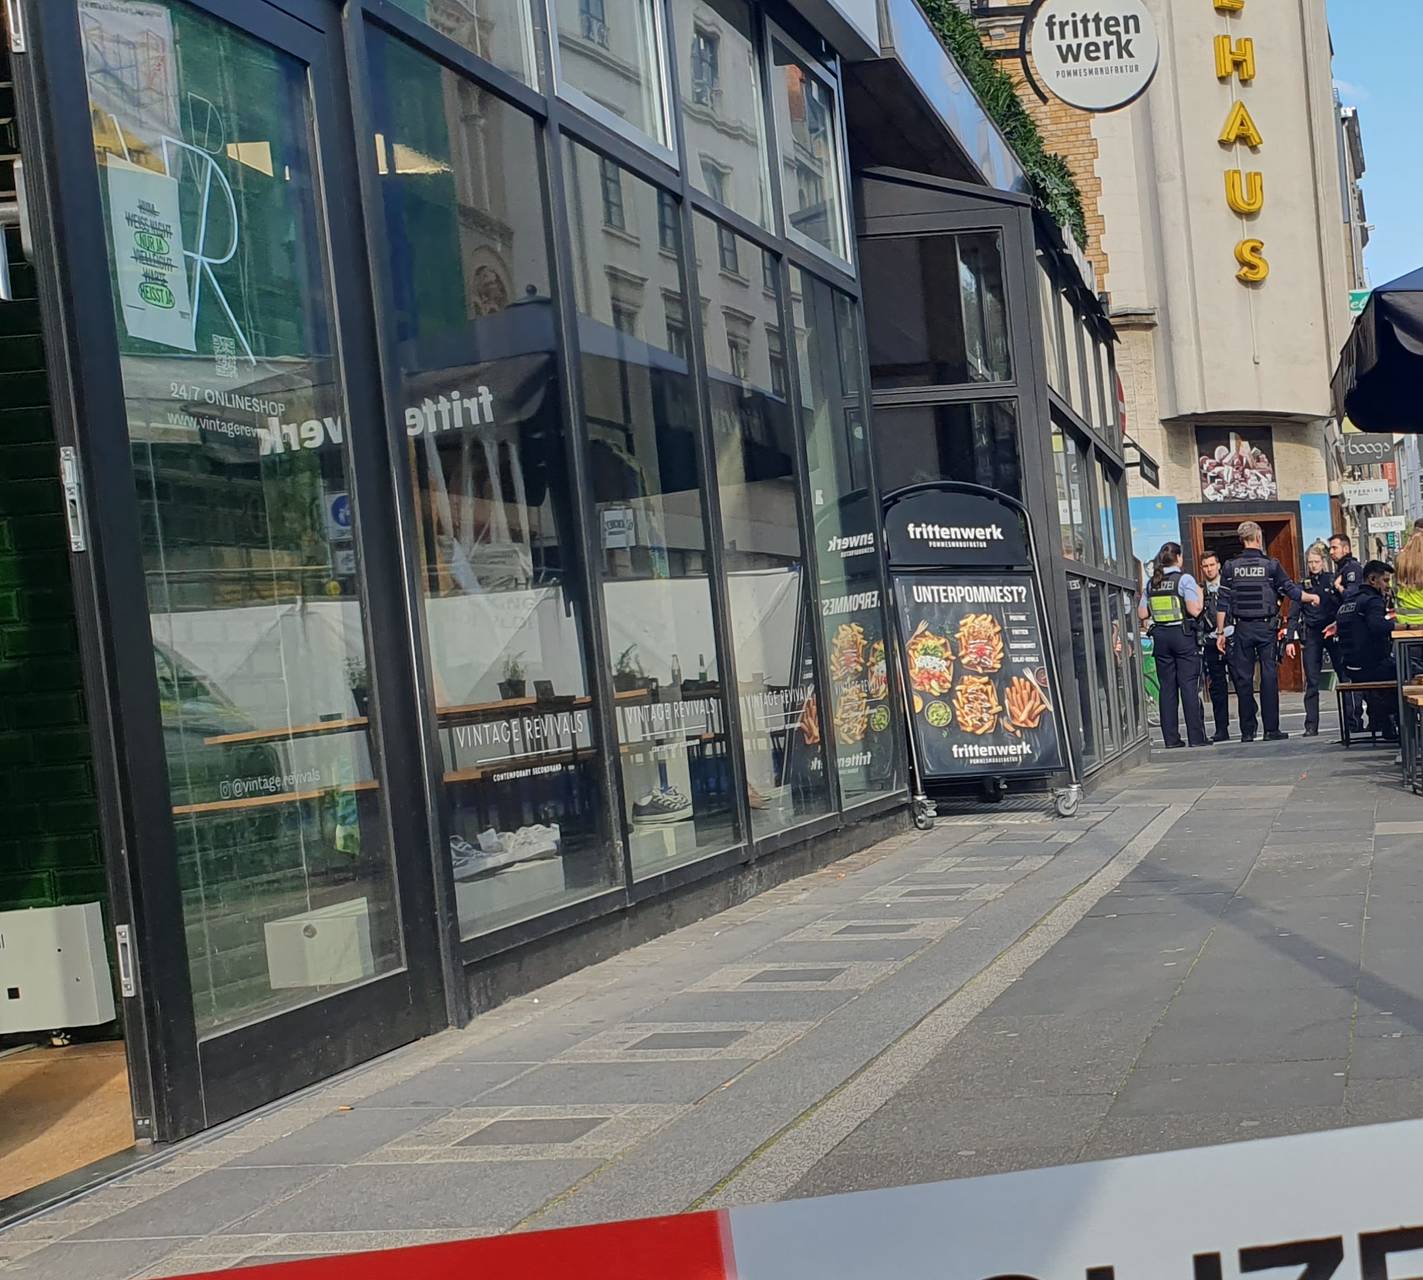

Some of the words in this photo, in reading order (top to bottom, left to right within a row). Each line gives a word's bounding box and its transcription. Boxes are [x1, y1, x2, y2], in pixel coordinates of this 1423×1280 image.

[1045, 13, 1141, 41] fritten
[1056, 31, 1136, 64] werk
[1056, 64, 1140, 79] POMMESMANUFAKTUR
[169, 382, 200, 402] 24/7
[204, 389, 286, 418] ONLINESHOP
[907, 523, 1004, 540] frittenwerk
[1234, 567, 1265, 577] POLIZEI
[912, 586, 1027, 603] UNTERPOMMEST?
[627, 703, 671, 723] VINTAGE
[673, 697, 715, 718] REVIVALS
[456, 720, 520, 748] VINTAGE
[525, 713, 583, 740] REVIVALS
[952, 741, 1032, 758] frittenwerk
